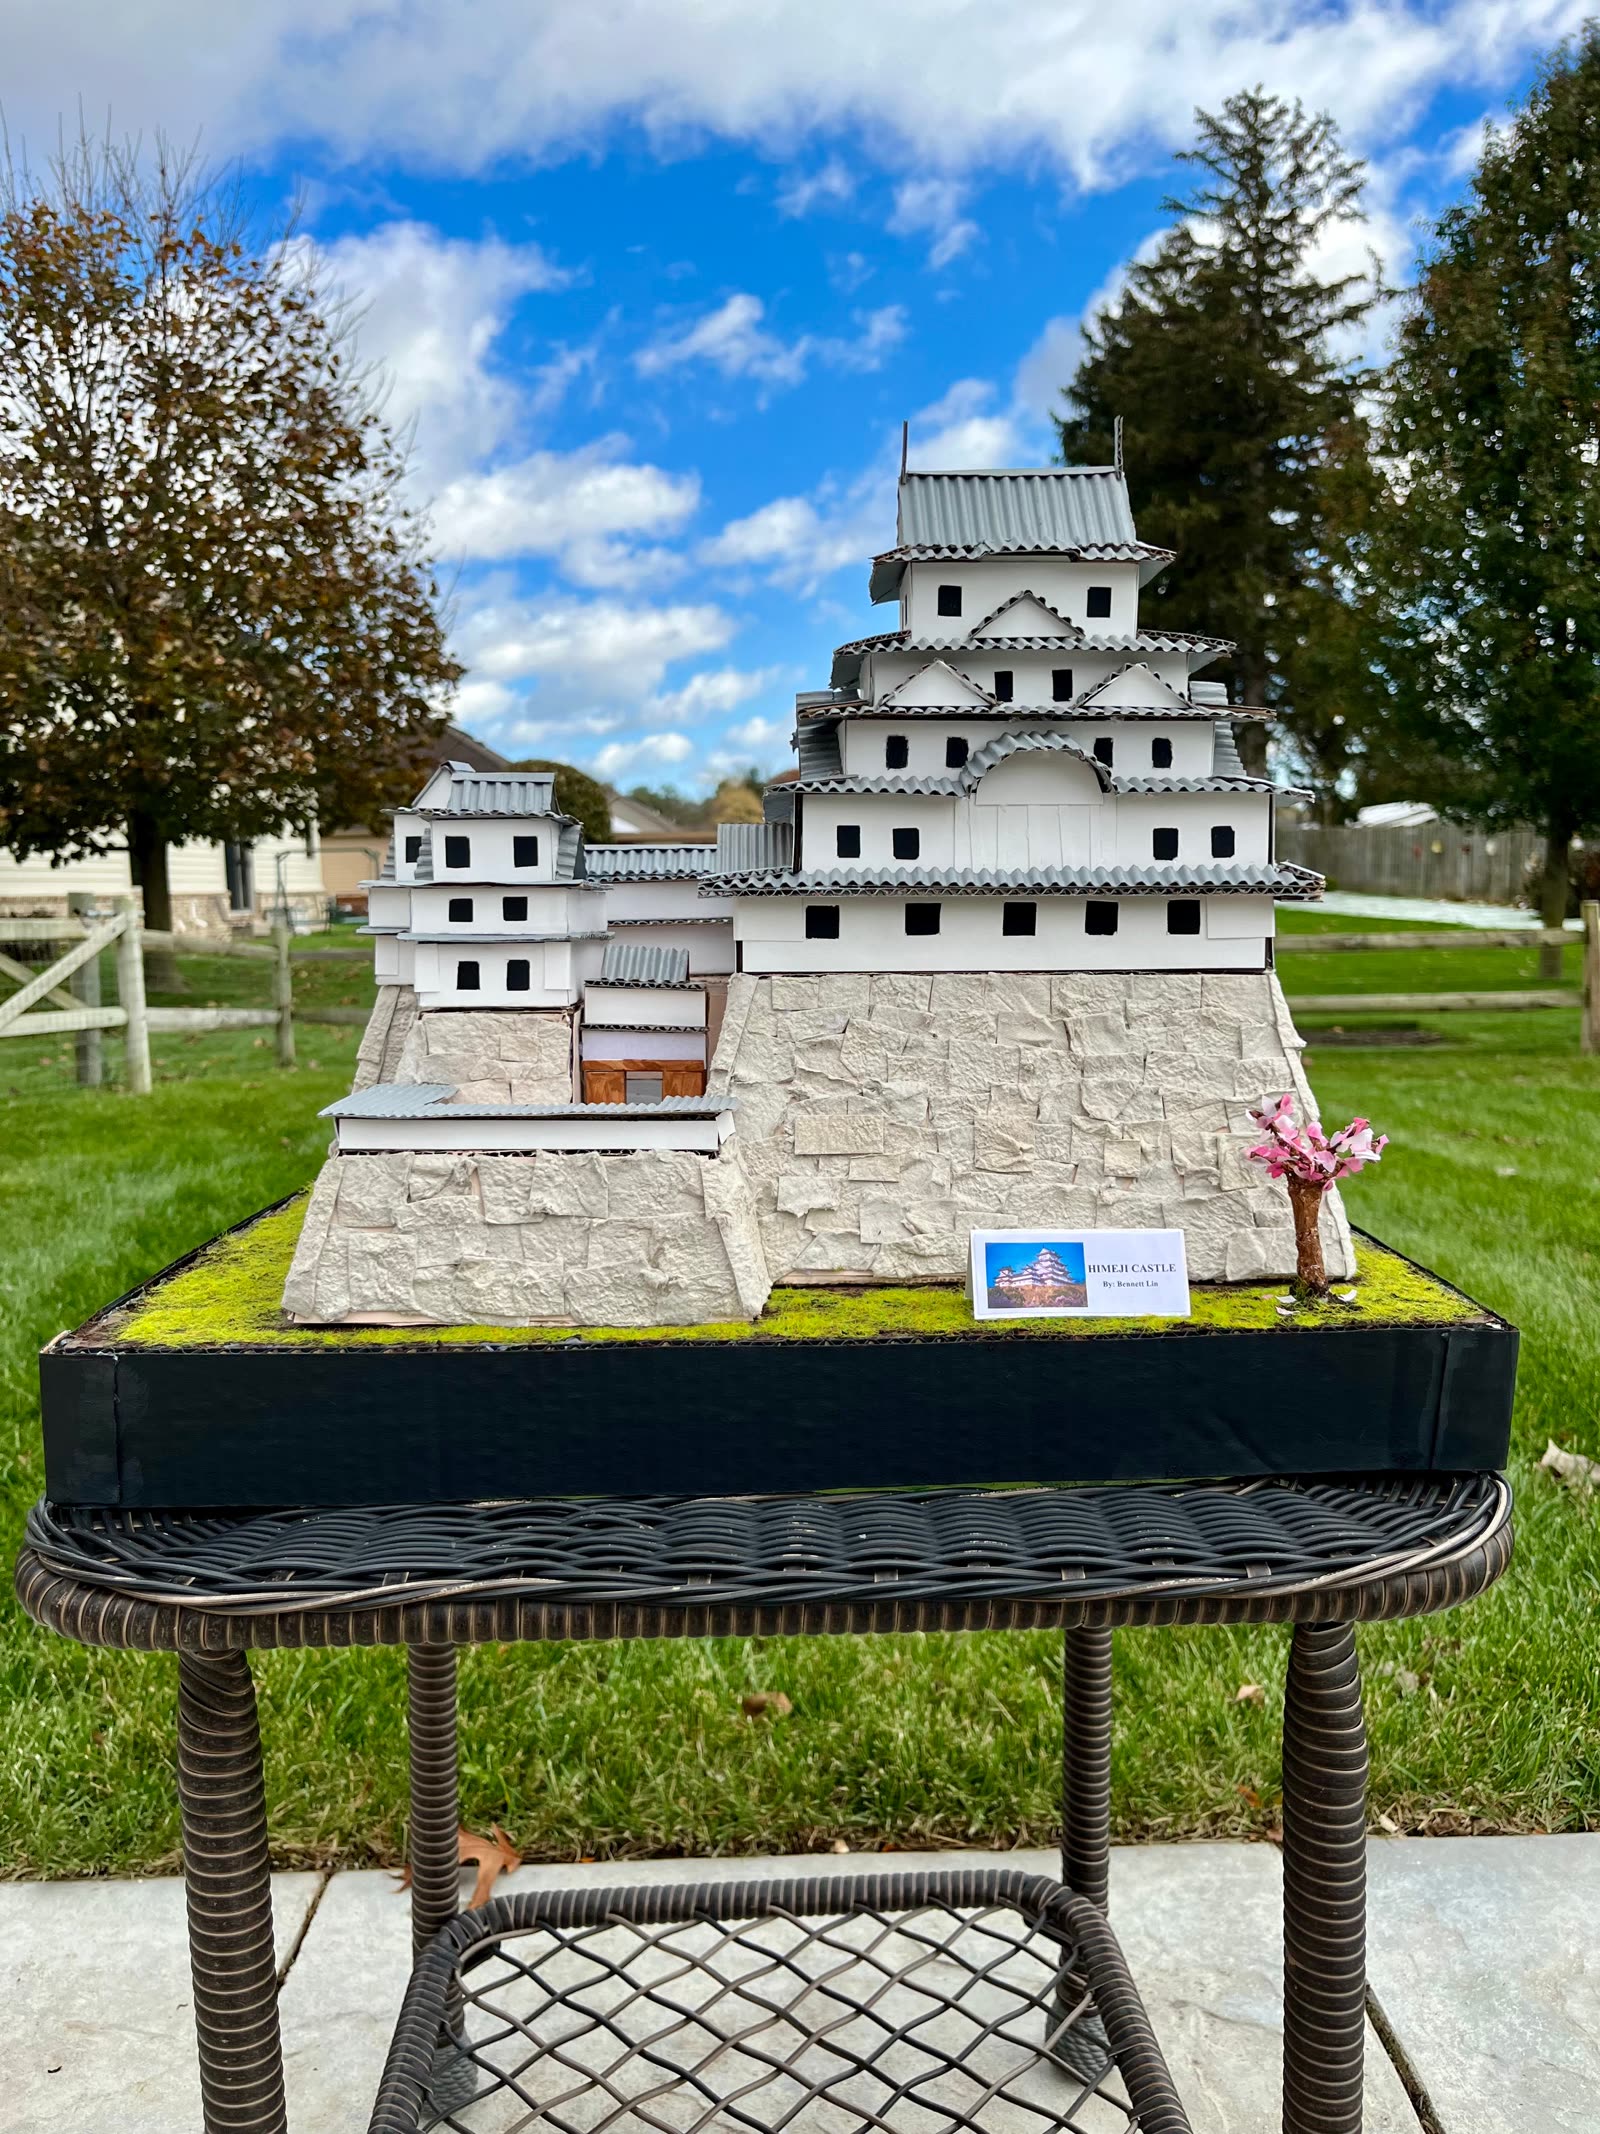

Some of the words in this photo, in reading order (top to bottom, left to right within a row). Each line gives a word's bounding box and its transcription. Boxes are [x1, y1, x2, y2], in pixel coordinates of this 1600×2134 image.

[1088, 1264, 1129, 1273] HIMEJI
[1131, 1263, 1177, 1273] CASTLE
[1103, 1281, 1115, 1289] By:
[1146, 1280, 1159, 1288] Lin
